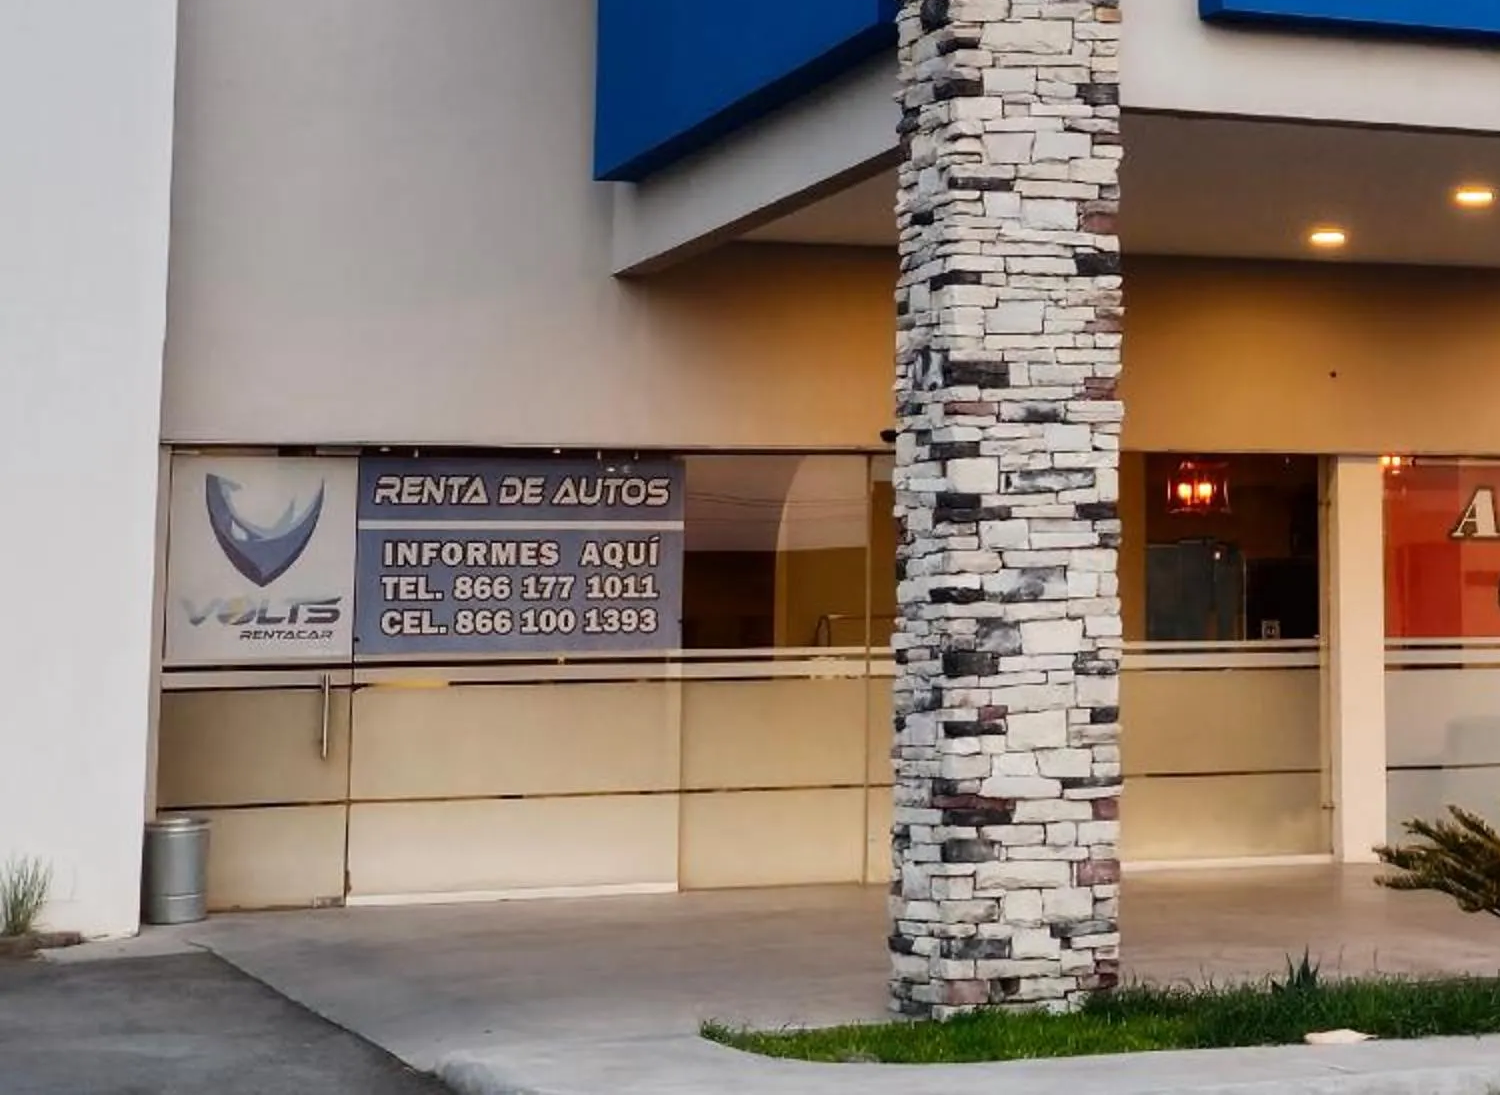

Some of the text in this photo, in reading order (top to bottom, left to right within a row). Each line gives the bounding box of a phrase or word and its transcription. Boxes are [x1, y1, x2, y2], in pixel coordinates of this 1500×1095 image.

[374, 475, 671, 506] RENTA DE AUTOS
[382, 534, 661, 568] INFORMES AQUÍ
[380, 575, 660, 601] TEL. 866 177 1011
[380, 608, 658, 636] CEL. 866 100 1393
